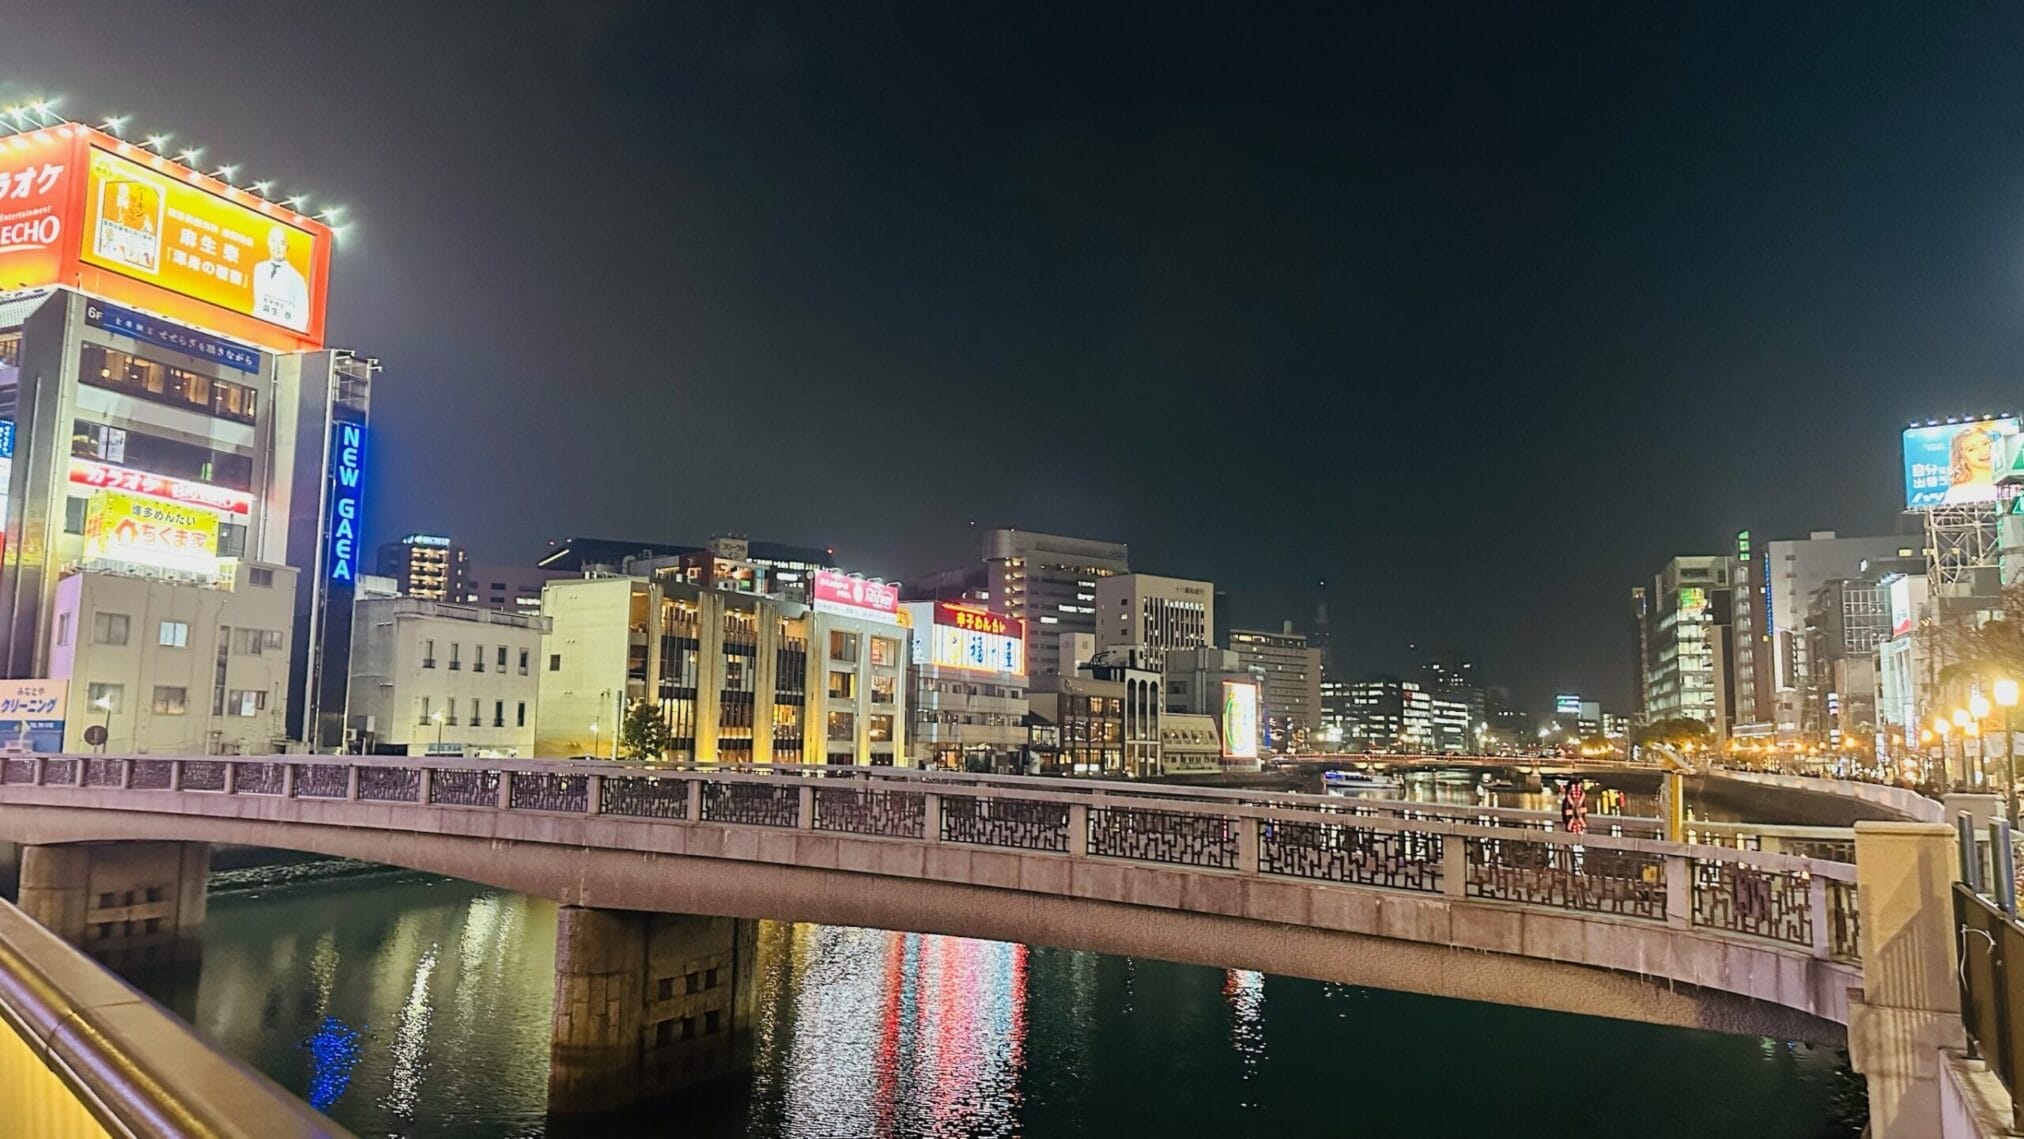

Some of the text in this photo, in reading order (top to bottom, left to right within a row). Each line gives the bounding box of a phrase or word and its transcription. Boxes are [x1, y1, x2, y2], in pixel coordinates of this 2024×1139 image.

[1, 215, 60, 244] ECHO
[87, 306, 104, 320] 6F
[332, 426, 360, 580] NEW GAEA
[132, 504, 196, 526] 博多めんたい
[1, 697, 58, 713] クリーニング
